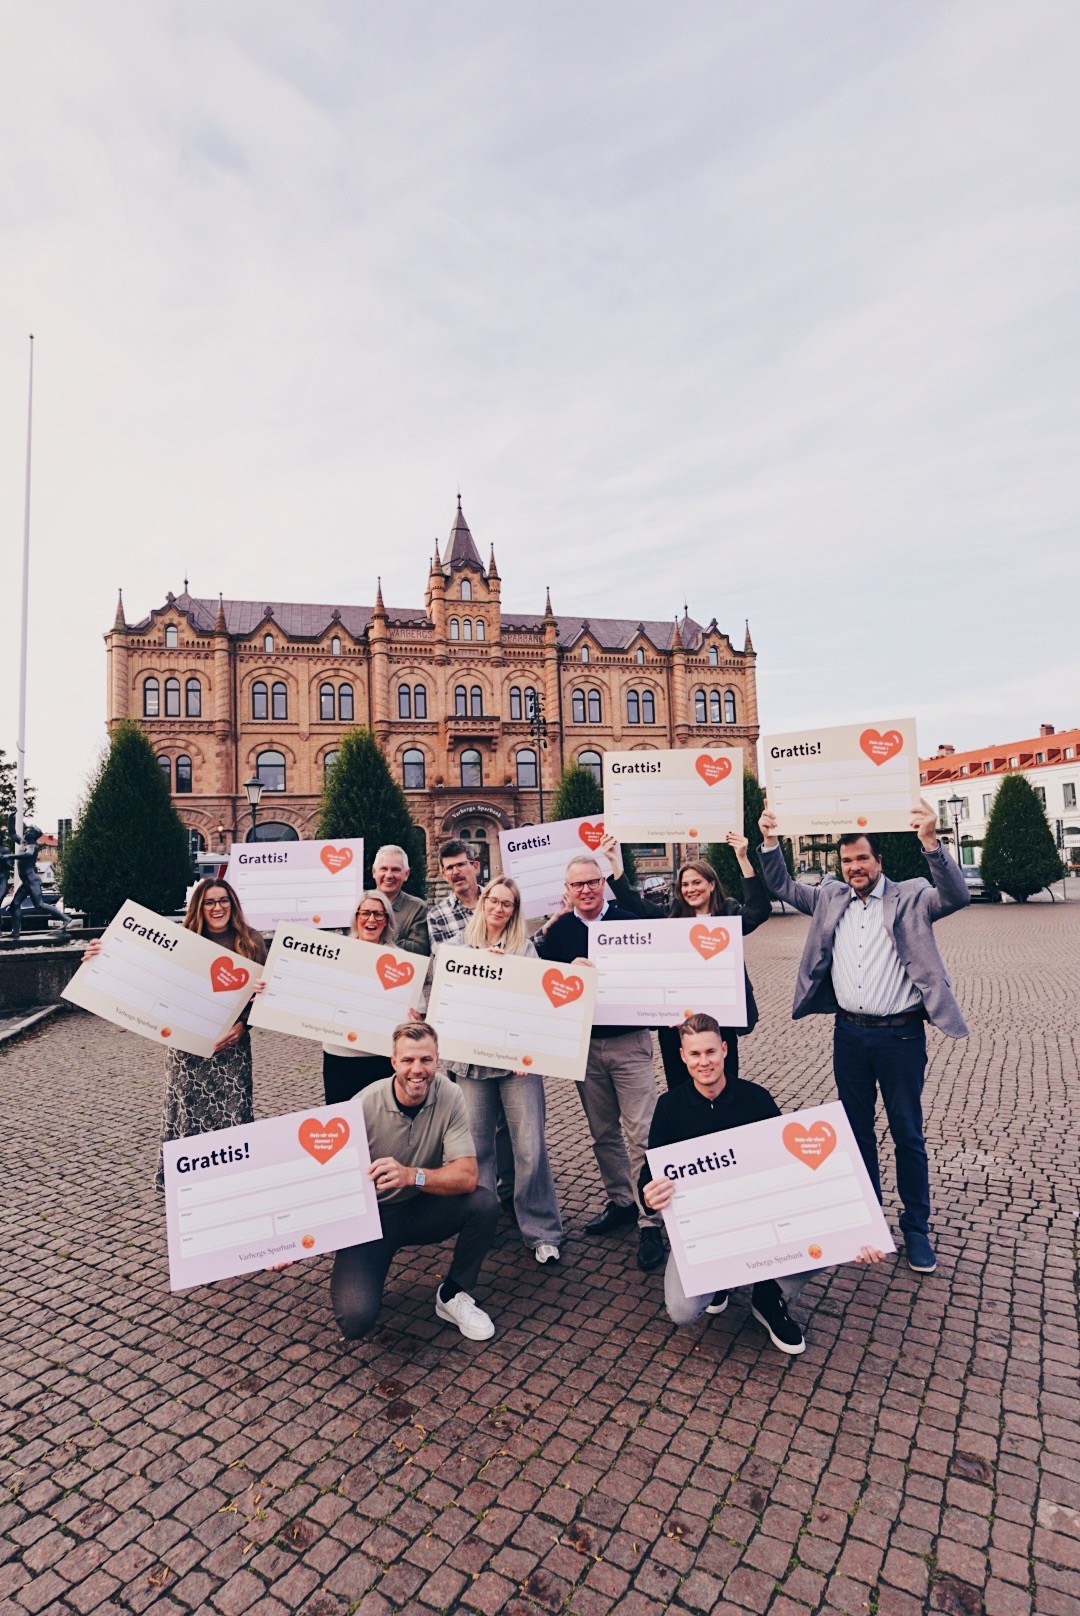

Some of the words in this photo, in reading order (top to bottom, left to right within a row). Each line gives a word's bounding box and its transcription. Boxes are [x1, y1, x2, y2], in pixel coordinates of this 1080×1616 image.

[388, 629, 433, 638] WARBERGS
[503, 634, 543, 644] SPARBANK
[771, 742, 821, 758] Grattis!
[612, 762, 660, 774] Grattis!
[452, 806, 475, 818] Varbergs
[477, 805, 501, 818] Sparbank
[508, 835, 550, 852] Grattis!
[239, 853, 288, 864] Grattis!
[122, 916, 178, 951] Grattis!
[598, 933, 652, 945] Grattis!
[282, 936, 340, 960] Grattis!
[445, 960, 502, 980] Grattis!
[116, 1007, 136, 1022] Varbergs
[136, 1016, 158, 1031] Sparbank
[301, 1022, 321, 1032] Varbergs
[322, 1027, 343, 1037] Sparbank
[473, 1049, 494, 1058] Varbergs
[495, 1053, 518, 1061] Sparbank
[176, 1142, 250, 1173] Grattis!
[664, 1149, 737, 1180] Grattis!
[238, 1251, 266, 1262] Varbergs
[267, 1243, 296, 1256] Sparbank
[746, 1258, 773, 1269] Varbergs
[774, 1252, 803, 1264] Sparbank
